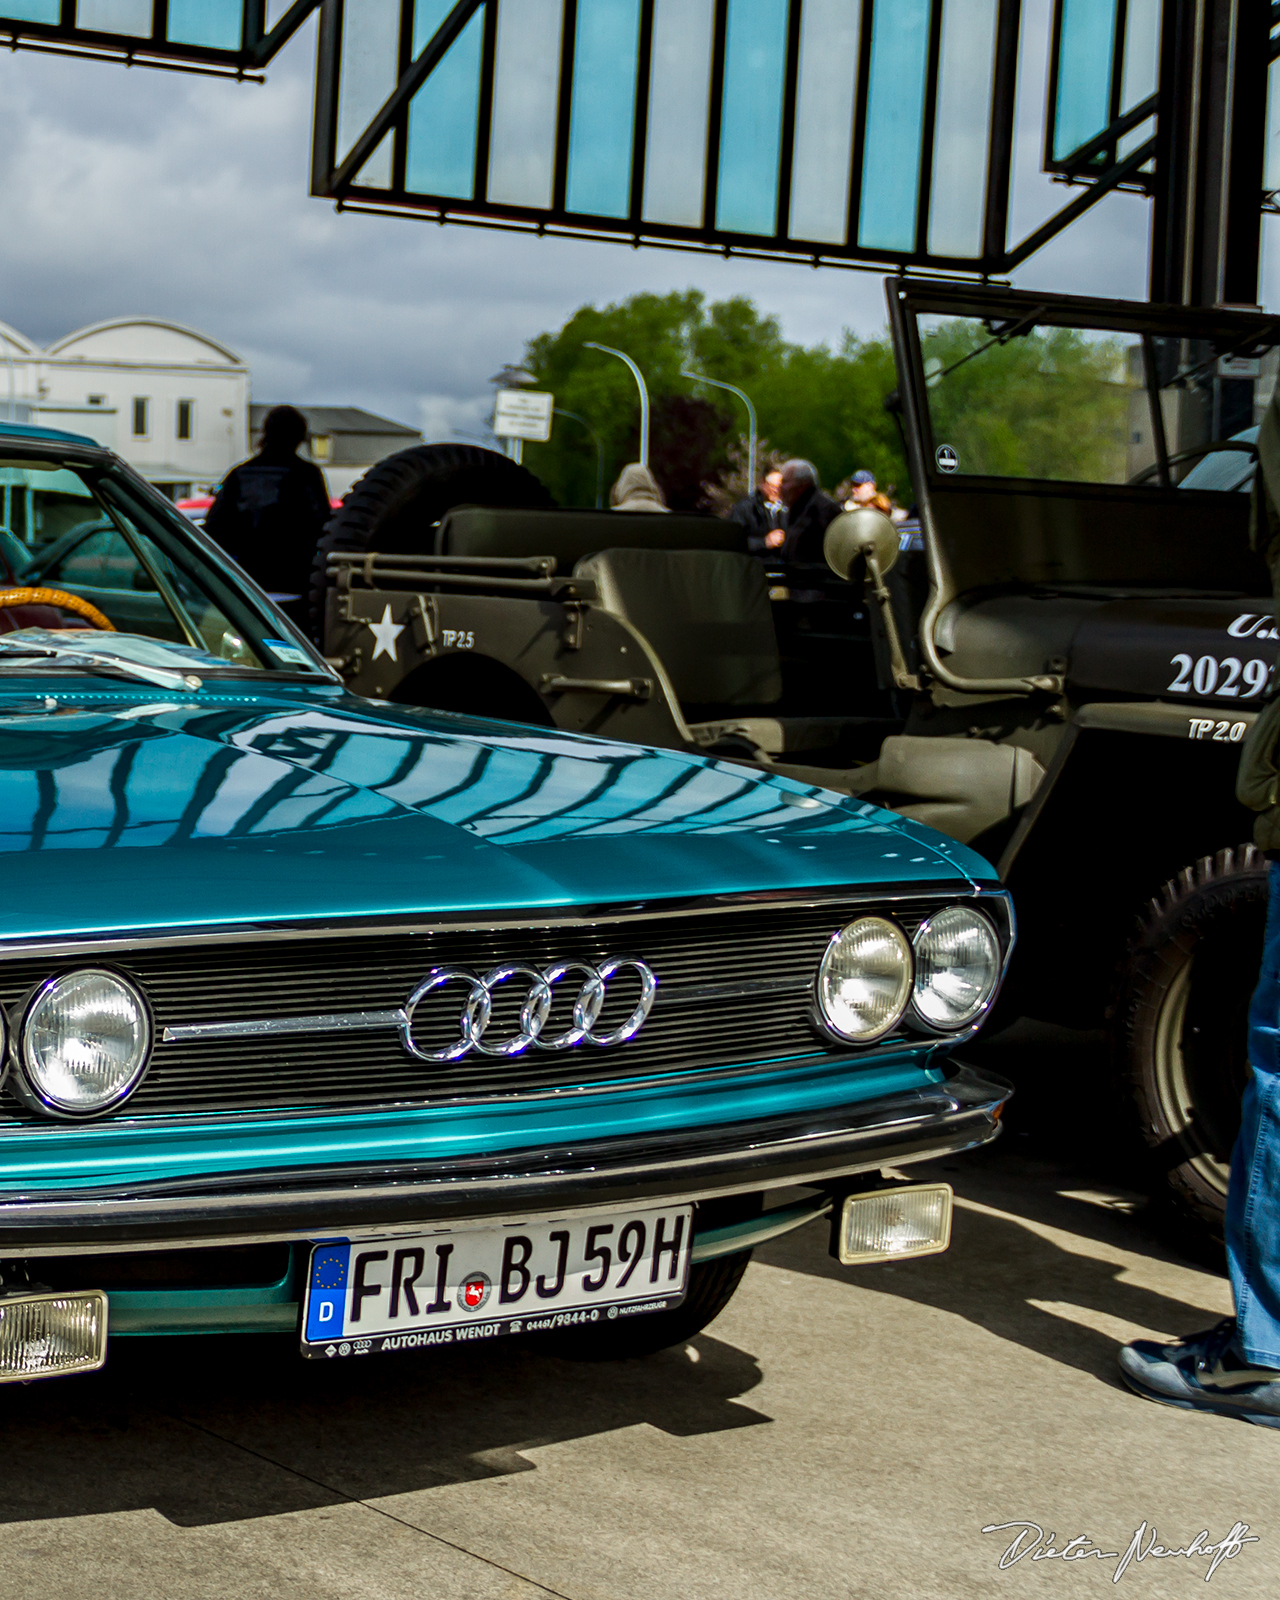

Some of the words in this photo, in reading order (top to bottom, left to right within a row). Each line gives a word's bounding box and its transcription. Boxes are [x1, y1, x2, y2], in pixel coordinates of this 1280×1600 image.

[1166, 653, 1277, 698] 2029
[350, 1243, 454, 1323] FRI
[319, 1301, 334, 1322] D
[381, 1330, 453, 1351] AUTOHAUS
[455, 1323, 501, 1341] WENDT
